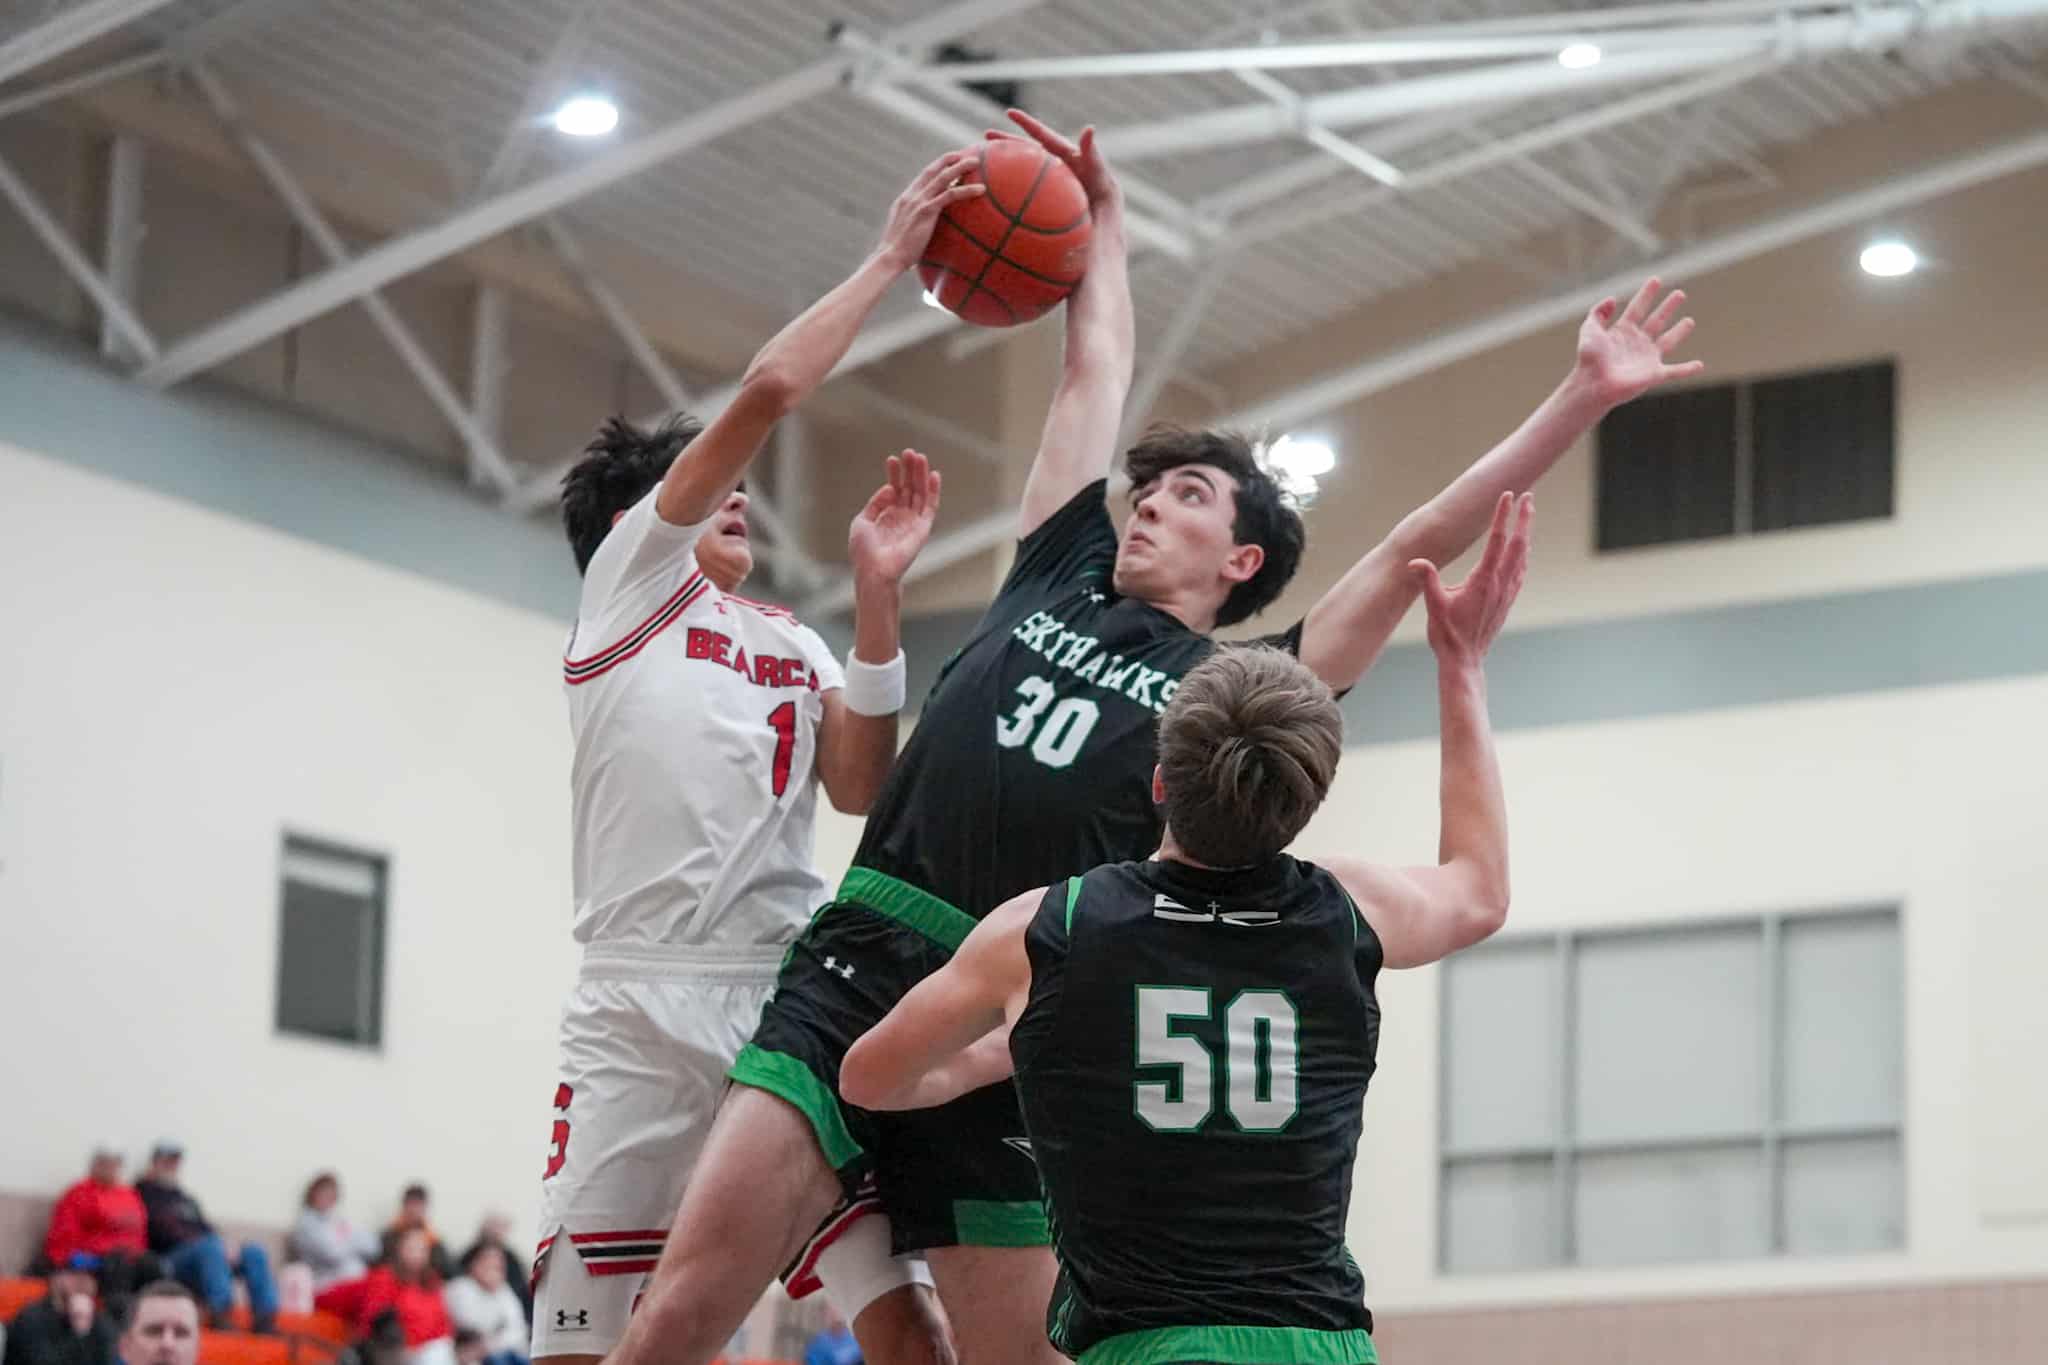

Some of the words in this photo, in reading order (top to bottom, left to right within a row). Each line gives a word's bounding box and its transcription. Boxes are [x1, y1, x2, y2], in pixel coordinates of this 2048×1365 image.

[1013, 611, 1181, 714] SKYHAWKS
[767, 700, 796, 799] 1
[996, 675, 1100, 769] 30
[1133, 983, 1299, 1132] 50
